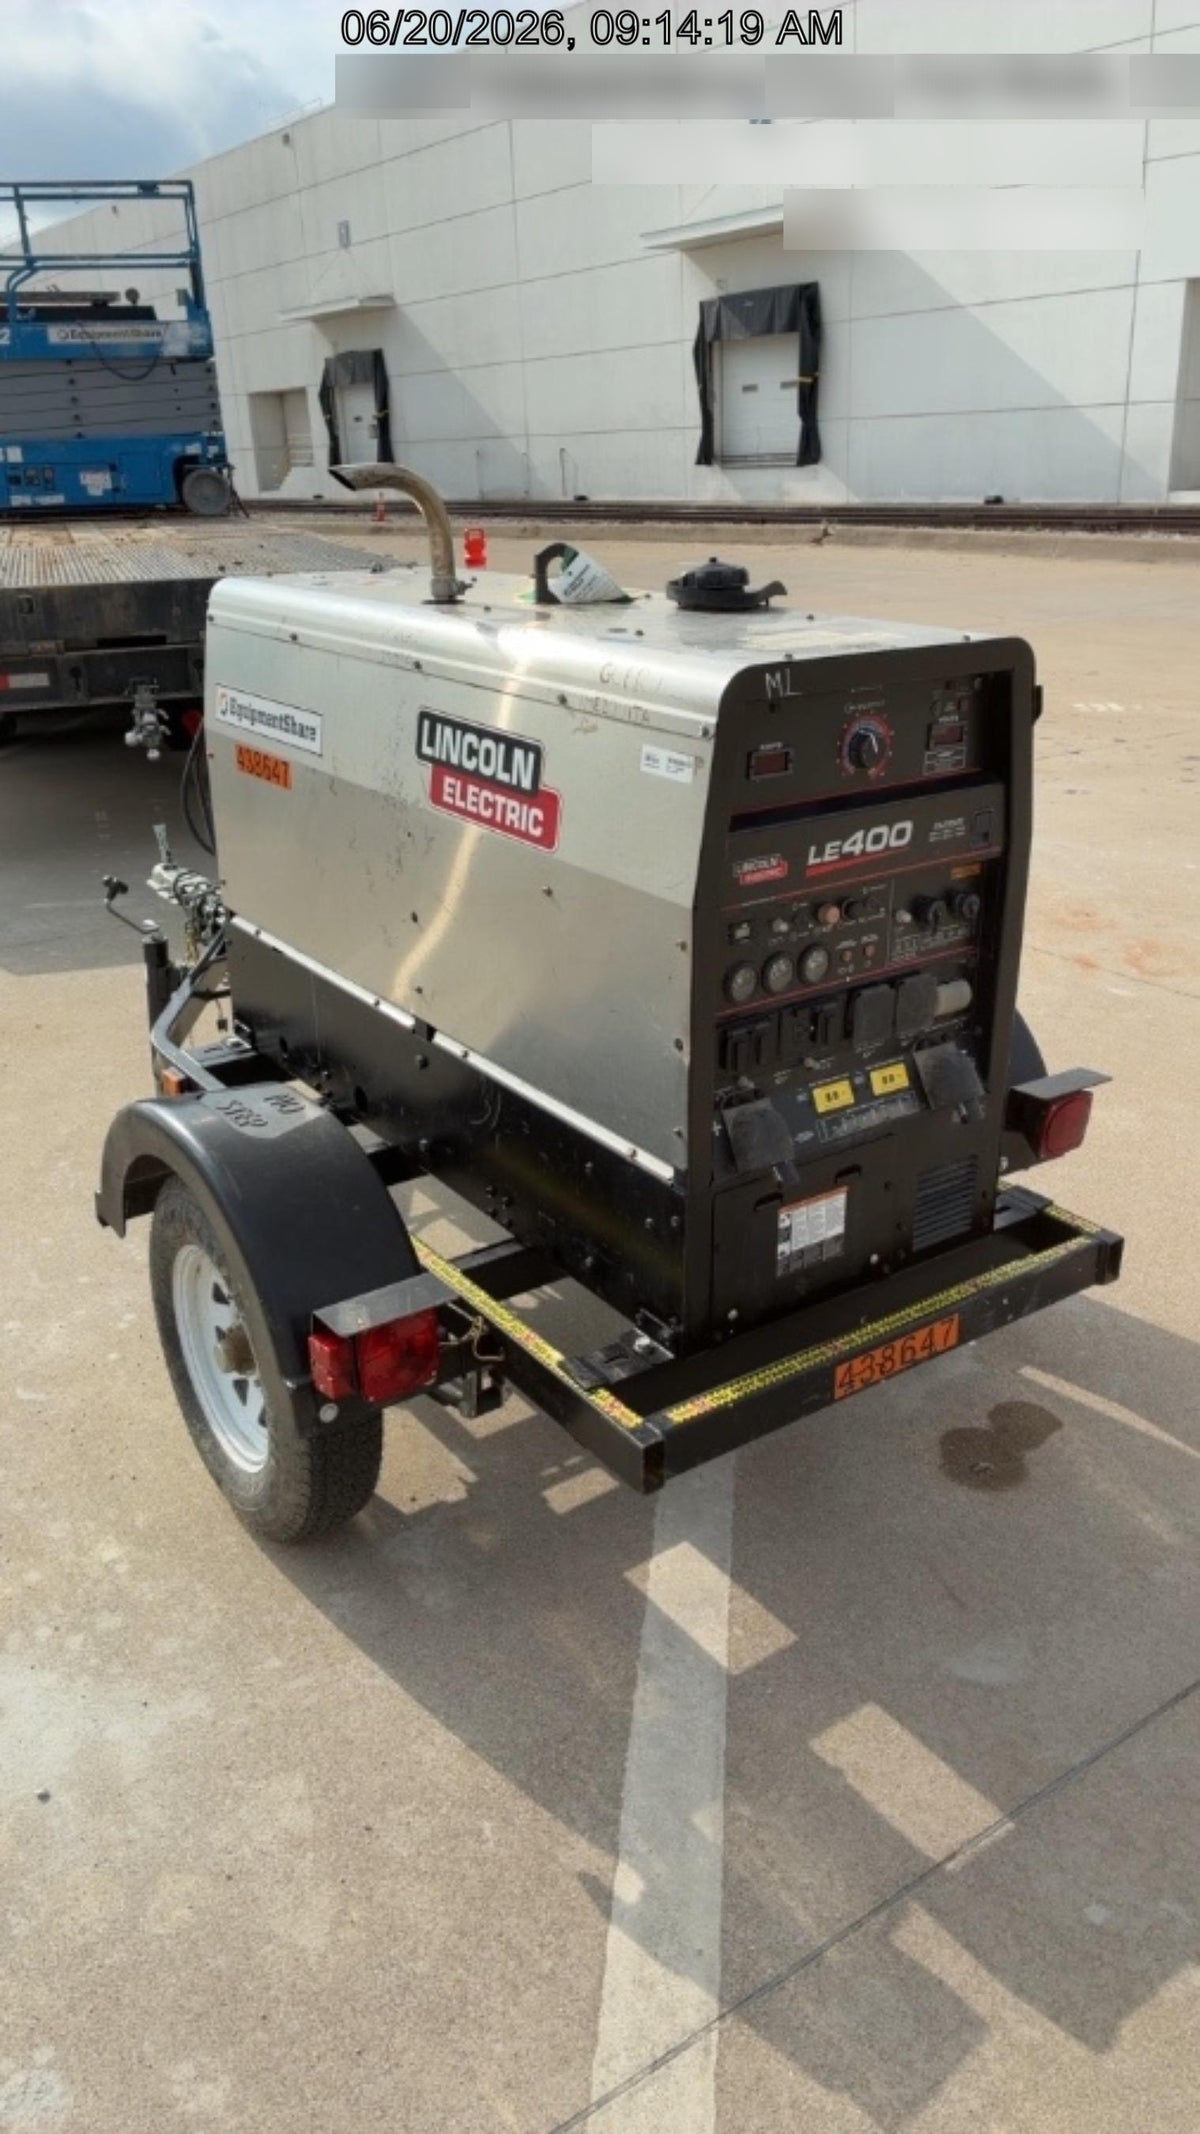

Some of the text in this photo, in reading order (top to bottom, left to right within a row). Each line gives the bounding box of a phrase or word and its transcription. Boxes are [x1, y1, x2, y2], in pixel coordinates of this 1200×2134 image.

[229, 696, 317, 743] EquipmentShare
[235, 743, 293, 790] 438647
[421, 719, 536, 791] LINCOLN
[442, 776, 545, 838] ELECTRIC
[807, 820, 914, 867] LE400
[837, 1318, 955, 1390] 438647
